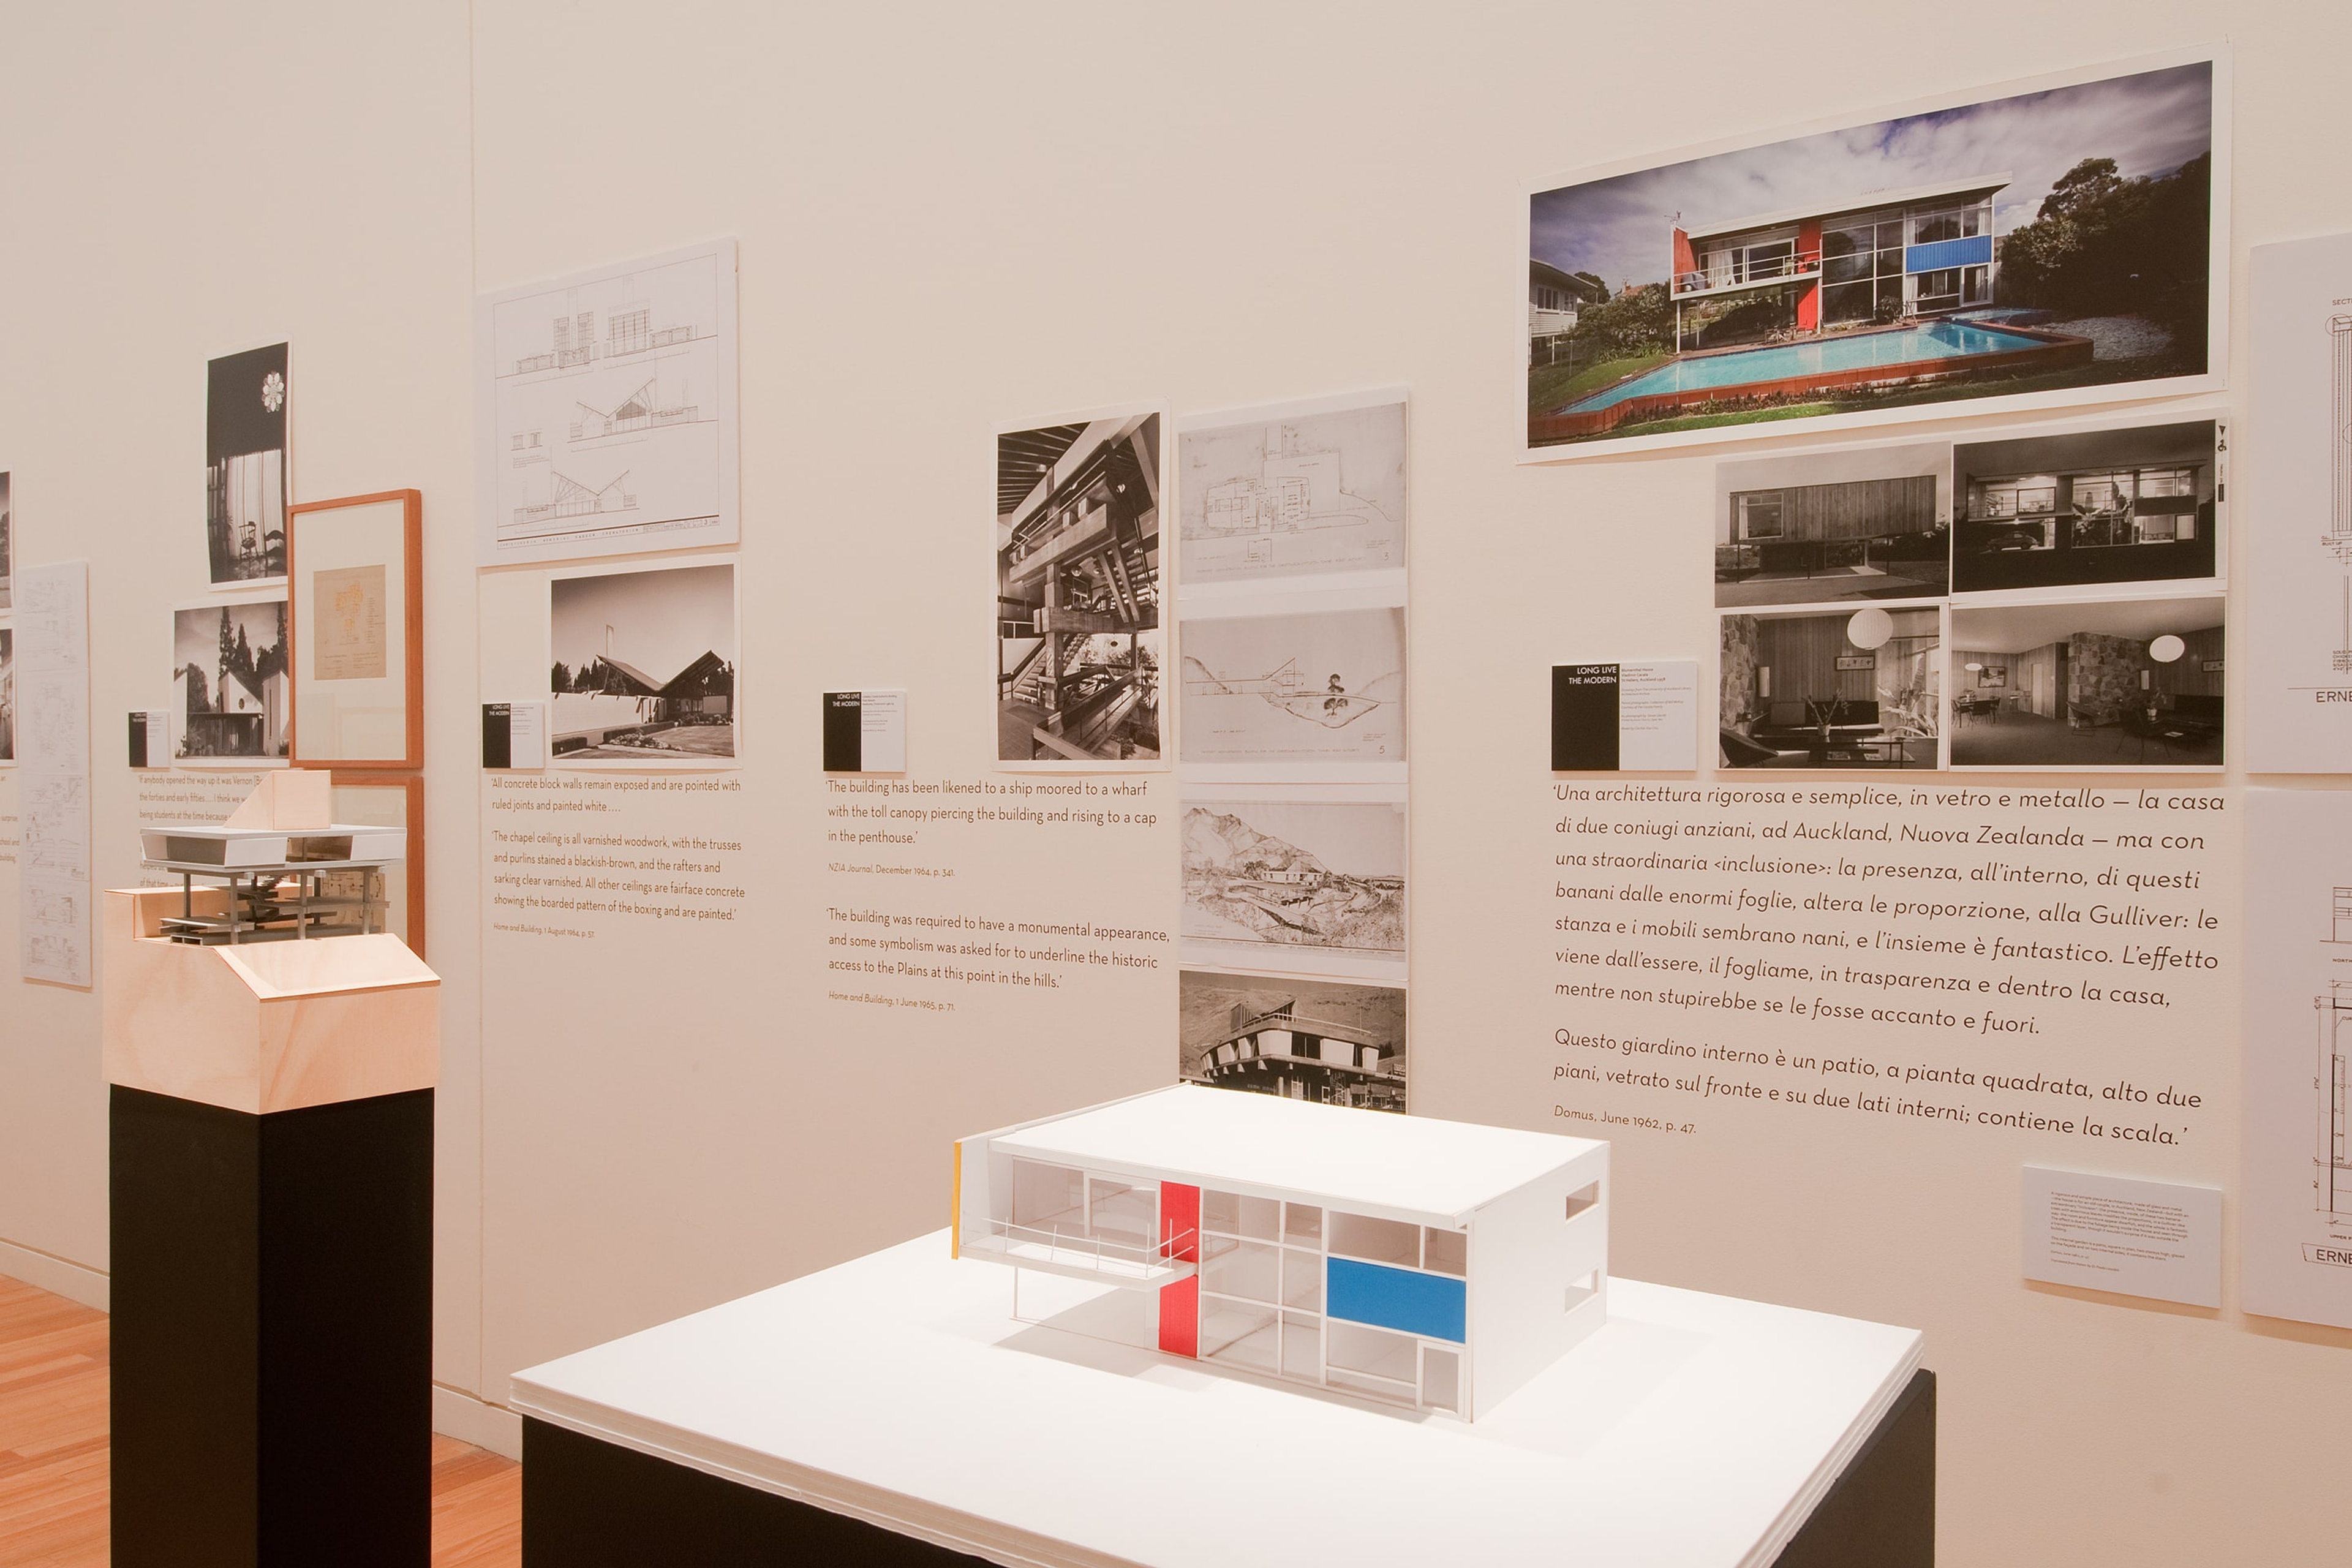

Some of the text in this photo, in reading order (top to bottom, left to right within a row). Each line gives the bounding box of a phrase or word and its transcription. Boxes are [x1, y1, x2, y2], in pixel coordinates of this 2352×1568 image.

[1379, 745, 1385, 755] 5
[503, 778, 538, 789] concrete
[540, 777, 561, 790] block
[562, 777, 582, 790] walls
[584, 778, 612, 790] remain
[614, 777, 649, 793] exposed
[650, 778, 667, 791] and
[669, 782, 684, 791] are
[685, 778, 719, 794] pointed
[722, 778, 741, 791] with
[850, 779, 889, 797] building
[892, 778, 910, 793] has
[913, 779, 940, 794] been
[942, 780, 981, 794] likened
[985, 781, 997, 794] to
[999, 785, 1006, 794] a
[1009, 780, 1033, 798] ship
[1036, 780, 1082, 795] moored
[1085, 782, 1098, 796] to
[1101, 786, 1108, 796] a
[1112, 780, 1148, 796] wharf
[827, 804, 1157, 828] with the toll canopy piercing the building and rising to a cap
[510, 831, 535, 845] chapel
[537, 831, 562, 847] ceiling
[564, 833, 570, 845] is
[571, 832, 581, 845] all
[582, 834, 622, 846] varnished
[624, 835, 670, 849] woodwork,
[671, 836, 690, 849] with
[692, 836, 707, 850] the
[709, 838, 742, 851] trusses
[828, 829, 837, 841] in
[839, 828, 856, 842] the
[1556, 855, 1586, 866] una
[1591, 851, 1708, 870] straordinaria
[1838, 857, 1856, 876] la
[1861, 865, 1962, 883] presenza,
[2097, 865, 2119, 886] di
[2126, 870, 2200, 892] questi
[1555, 880, 2218, 930] banani dalle enormi foglie, altera le proporzione, alla Gulliver: le
[850, 908, 891, 928] building
[892, 916, 913, 925] was
[915, 914, 961, 930] required
[964, 916, 976, 929] to
[979, 916, 1005, 931] have
[1008, 922, 1014, 932] a
[1018, 922, 1090, 937] monumental
[1094, 927, 1170, 943] appearance,
[1555, 915, 1611, 933] stanza
[1616, 922, 1626, 934] e
[1632, 919, 1637, 935] i
[1642, 919, 1697, 938] mobili
[1702, 922, 1796, 944] sembrano
[1802, 930, 1849, 949] nani,
[1856, 937, 1868, 948] e
[1973, 936, 1986, 955] è
[1991, 937, 2113, 963] fantastico.
[1556, 948, 1600, 965] viene
[1709, 956, 1720, 973] il
[1723, 956, 1813, 982] fogliame,
[1821, 965, 1838, 982] in
[1845, 967, 1970, 992] trasparenza
[1978, 981, 1991, 993] e
[1998, 974, 2072, 998] dentro
[2081, 980, 2101, 1001] la
[2109, 990, 2170, 1008] casa,
[1555, 982, 2039, 1035] mentre non stupirebbe se le fosse accanto e fuori.
[1555, 1028, 2201, 1108] Questo giardino interno è un patio, a pianta quadrata, alto due
[1554, 1104, 1697, 1134] Domus, June 1962, p. 47.
